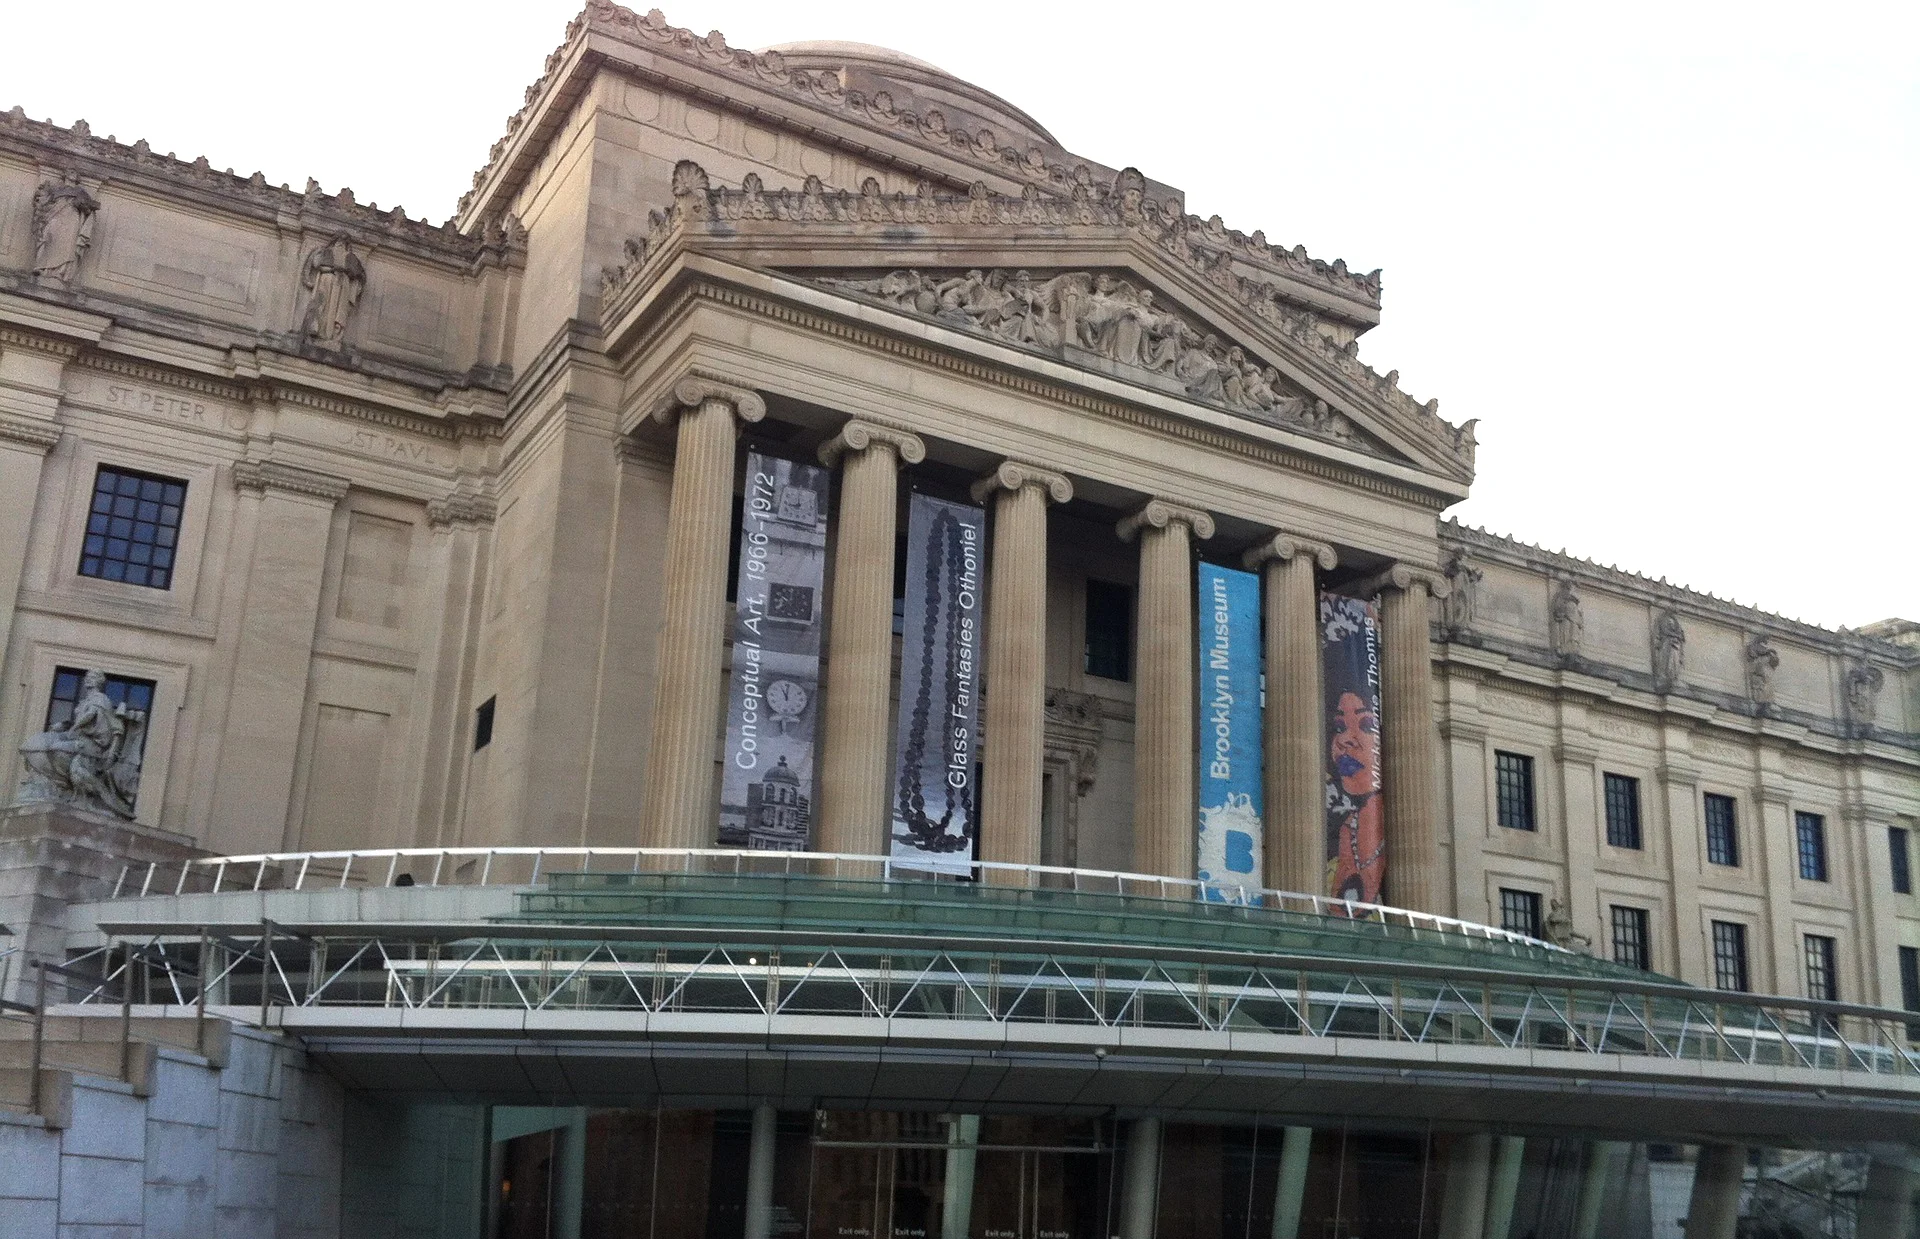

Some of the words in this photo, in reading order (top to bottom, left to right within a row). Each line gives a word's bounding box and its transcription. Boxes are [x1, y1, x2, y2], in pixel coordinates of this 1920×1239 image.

[746, 472, 774, 581] 1966-1972
[958, 523, 976, 610] Othoniel
[743, 594, 767, 636] Art,
[1209, 577, 1230, 670] Museum
[1365, 616, 1378, 687] Thomas
[735, 640, 763, 770] Conceptual
[952, 617, 974, 719] Fantasies
[948, 726, 968, 789] Glass
[1210, 674, 1234, 781] Brooklyn
[895, 1227, 909, 1236] Exit
